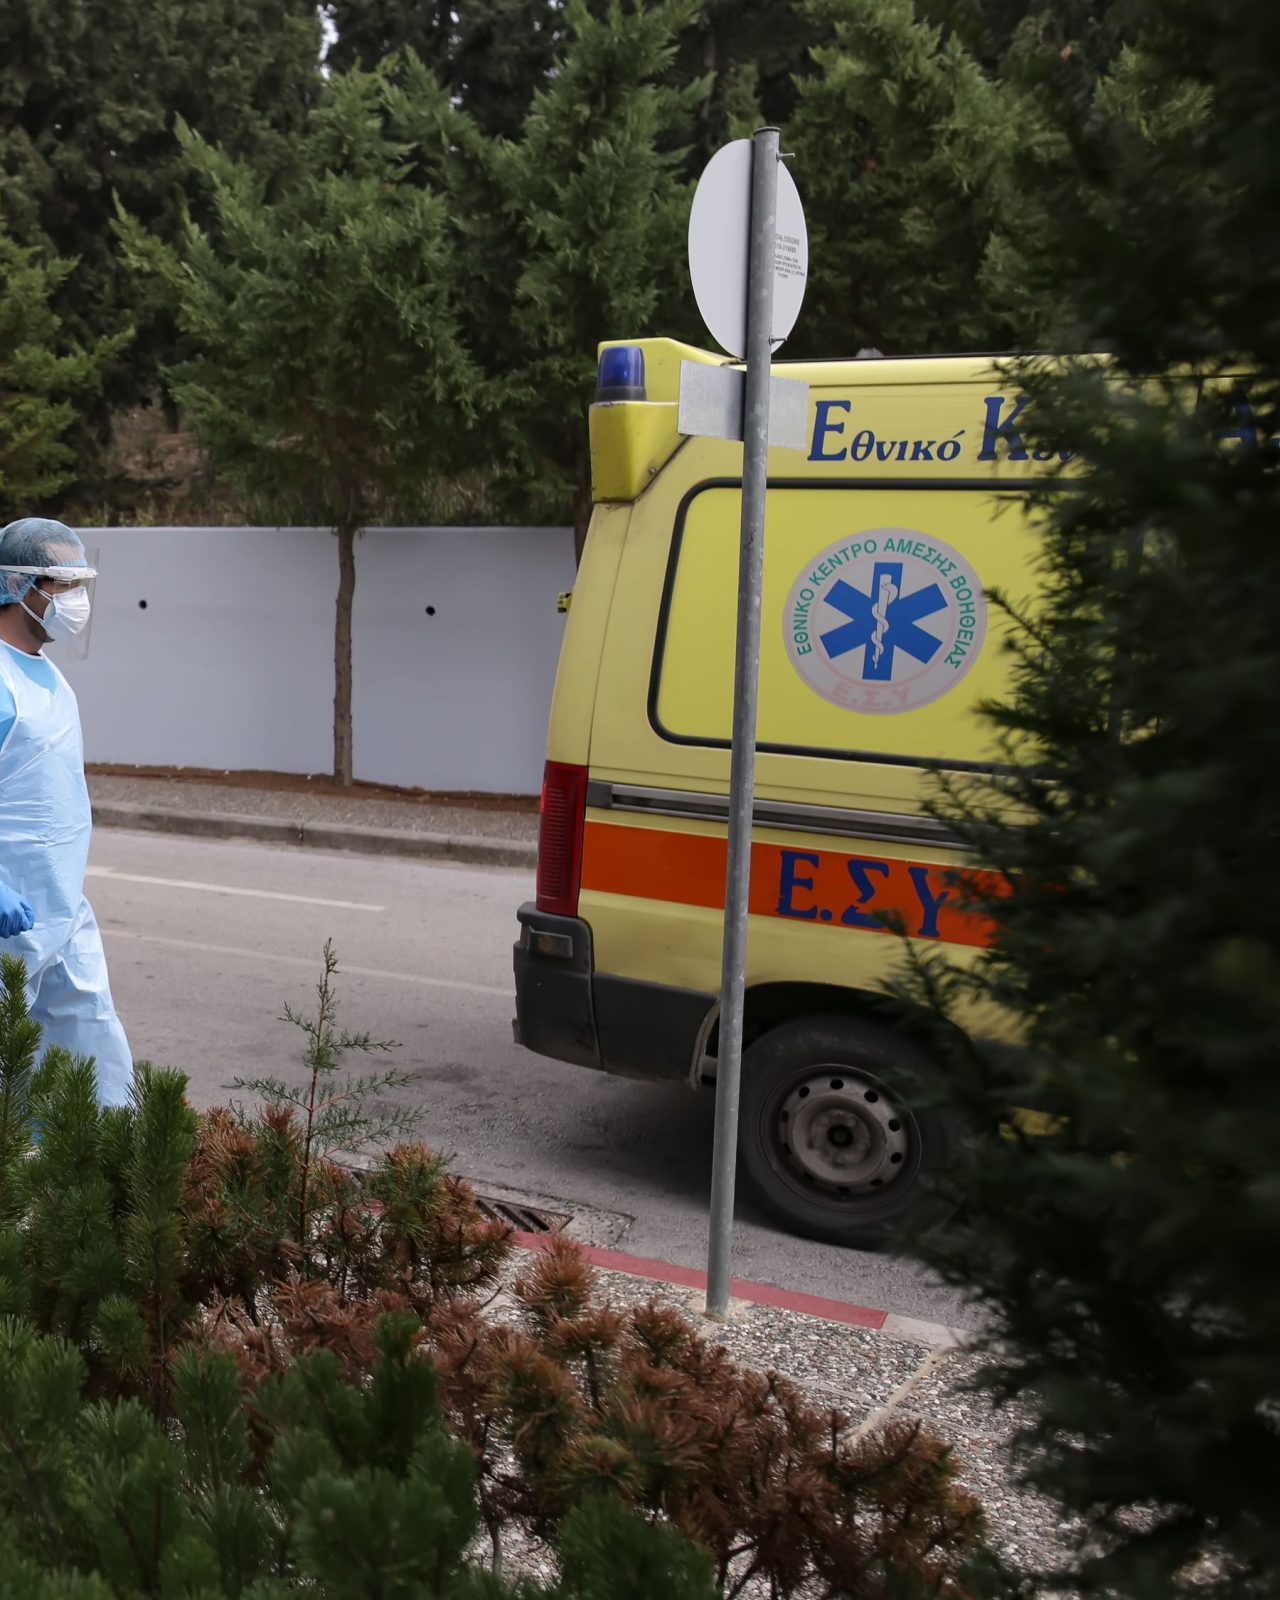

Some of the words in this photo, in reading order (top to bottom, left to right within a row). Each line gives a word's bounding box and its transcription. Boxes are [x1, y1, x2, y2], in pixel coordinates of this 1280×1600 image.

[807, 400, 966, 462] Εθνικό
[793, 588, 815, 656] ΕΘΝΙΚΟ
[808, 539, 877, 587] ΚΕΝΤΡΟ
[883, 537, 957, 577] ΑΜΕΣΗΣ
[944, 575, 976, 669] ΒΟΗΘΕΙΑΣ
